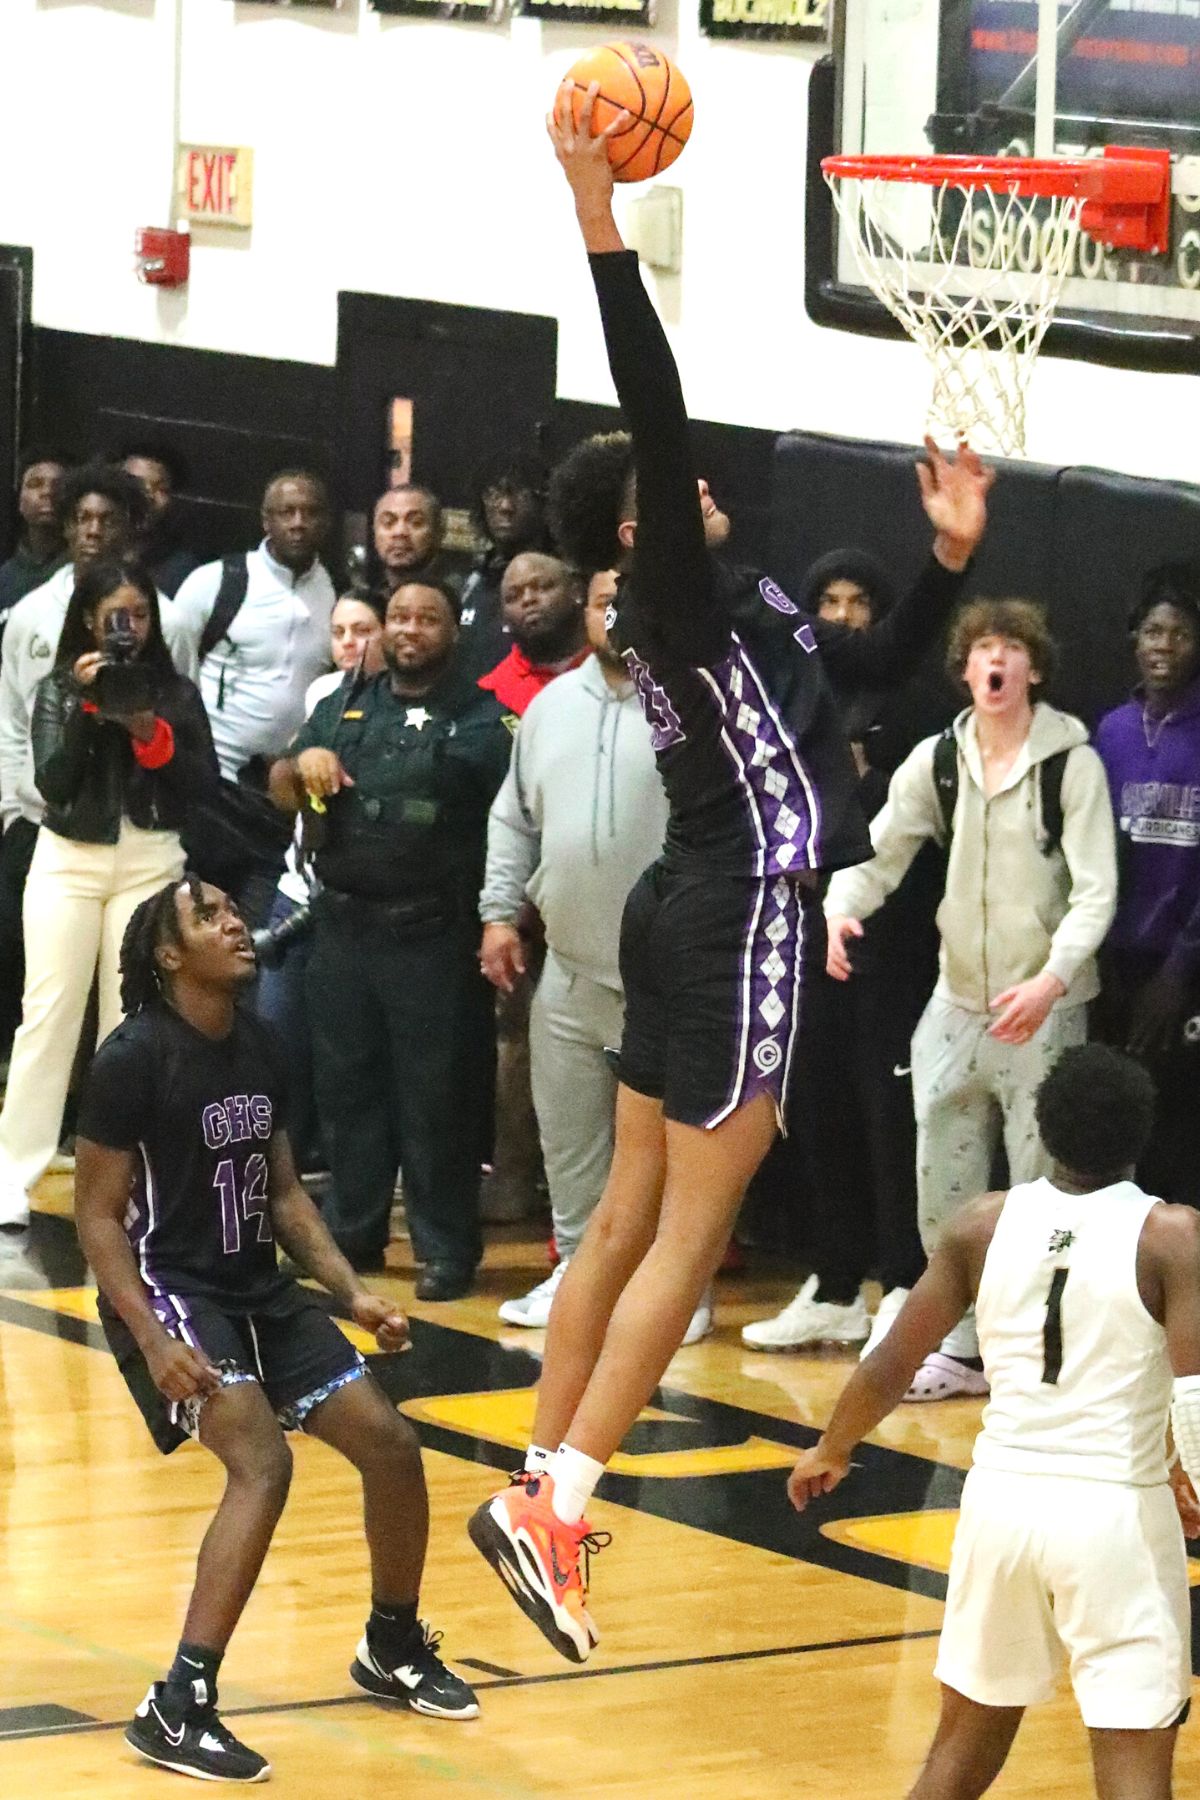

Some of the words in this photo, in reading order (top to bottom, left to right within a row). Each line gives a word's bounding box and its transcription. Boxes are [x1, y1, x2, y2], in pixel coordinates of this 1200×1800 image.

[187, 151, 237, 213] EXIT
[202, 1094, 273, 1150] GHS
[212, 1153, 273, 1254] 14
[1041, 1267, 1070, 1385] 1
